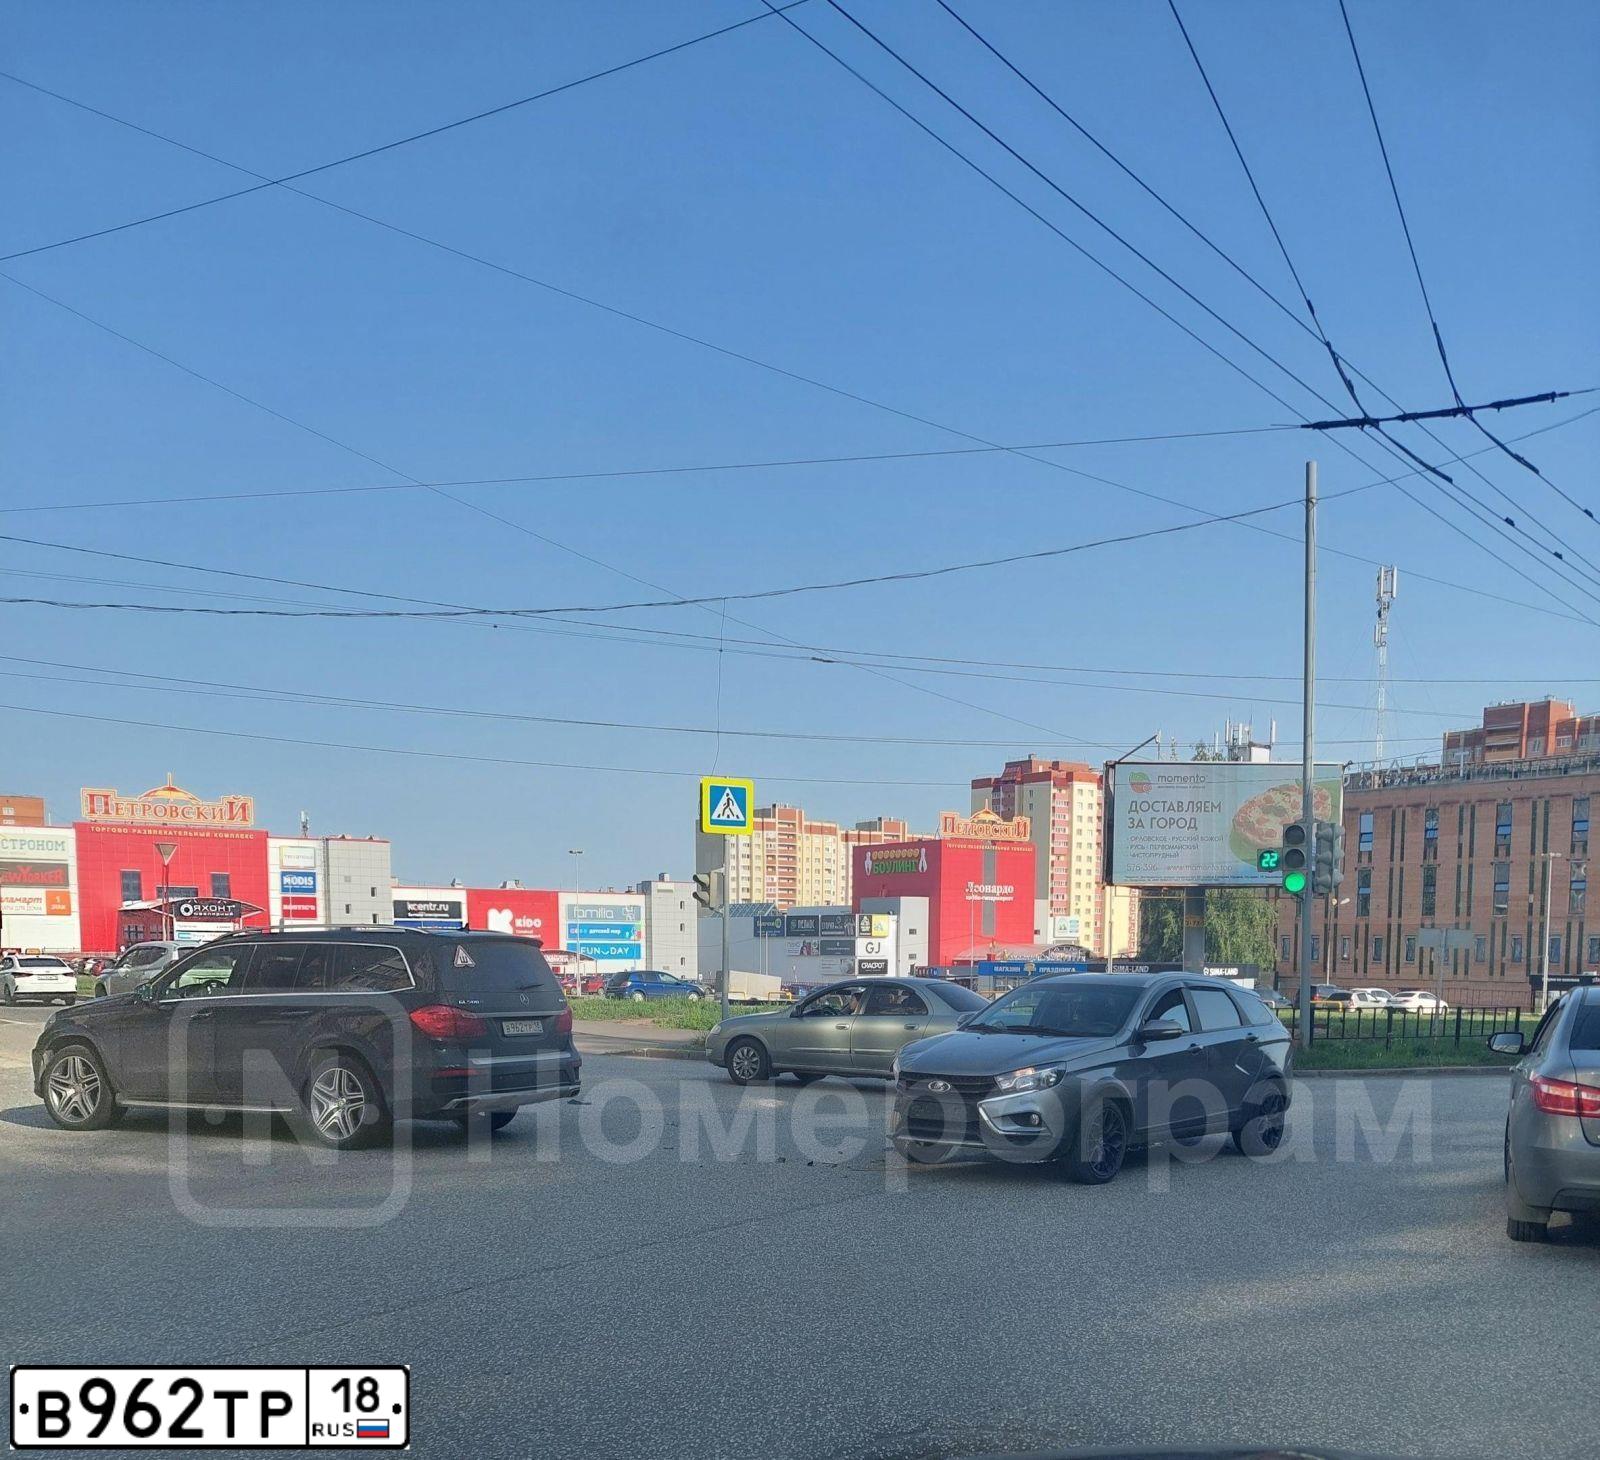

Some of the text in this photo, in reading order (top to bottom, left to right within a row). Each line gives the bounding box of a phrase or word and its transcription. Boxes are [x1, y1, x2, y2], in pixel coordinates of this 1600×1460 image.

[1157, 774, 1206, 783] momento
[1128, 801, 1222, 814] ДОСТАВЛЯЕМ
[1128, 817, 1198, 831] ЗА ГОРОД
[1261, 852, 1278, 867] 22
[873, 860, 917, 874] БОУЛИНГ
[282, 875, 314, 886] MODIS
[965, 881, 1014, 896] Леонардо
[574, 905, 615, 919] familia
[580, 946, 630, 955] FUN DAY
[865, 941, 881, 954] GJ
[1112, 965, 1150, 974] SIMA-LAND
[1209, 967, 1239, 976] SIMA-LAND
